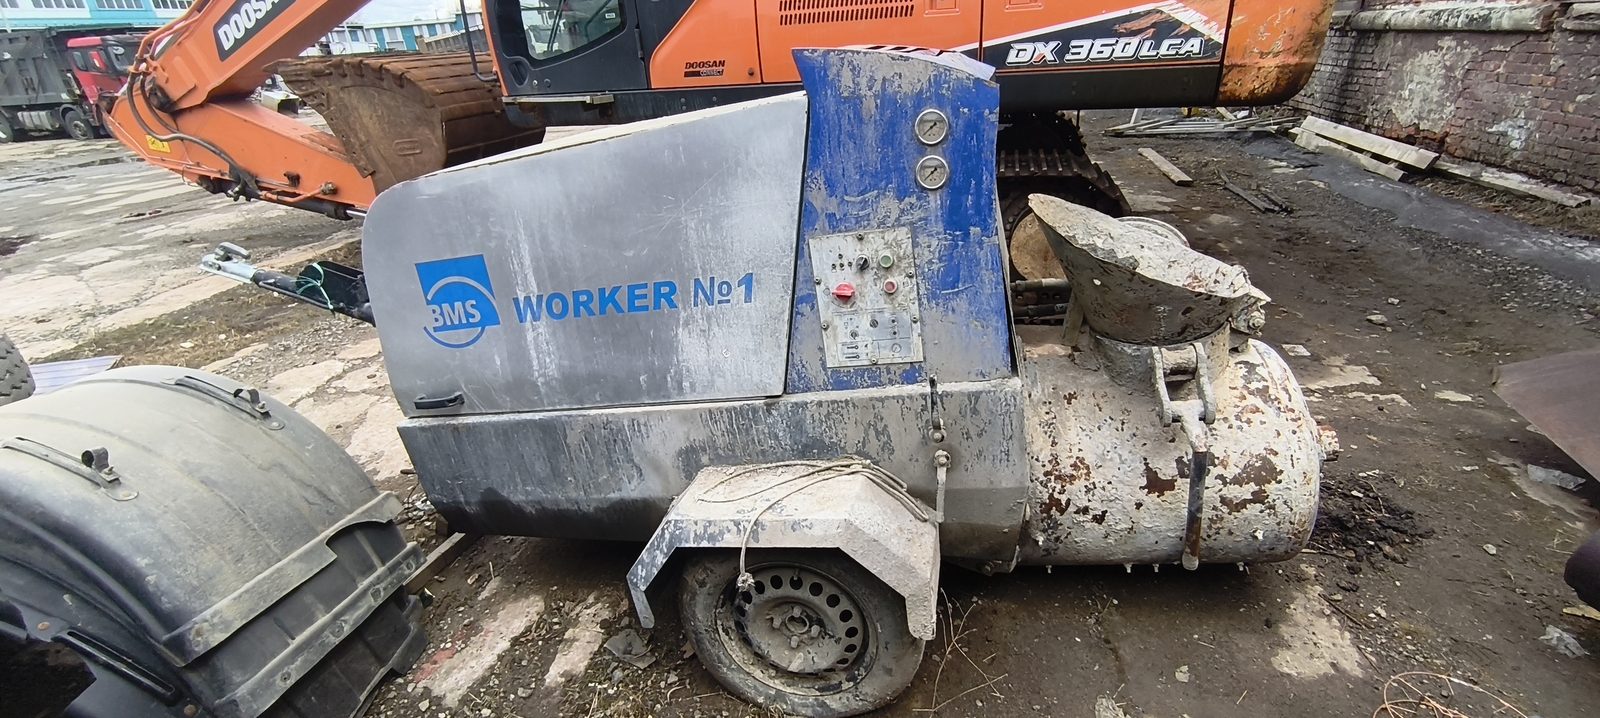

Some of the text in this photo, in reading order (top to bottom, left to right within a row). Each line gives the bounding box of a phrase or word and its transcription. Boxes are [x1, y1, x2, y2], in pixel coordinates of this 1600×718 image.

[684, 60, 726, 69] DOOSAN
[1006, 41, 1062, 66] DX
[426, 299, 482, 328] BMS
[512, 279, 678, 323] WORKER
